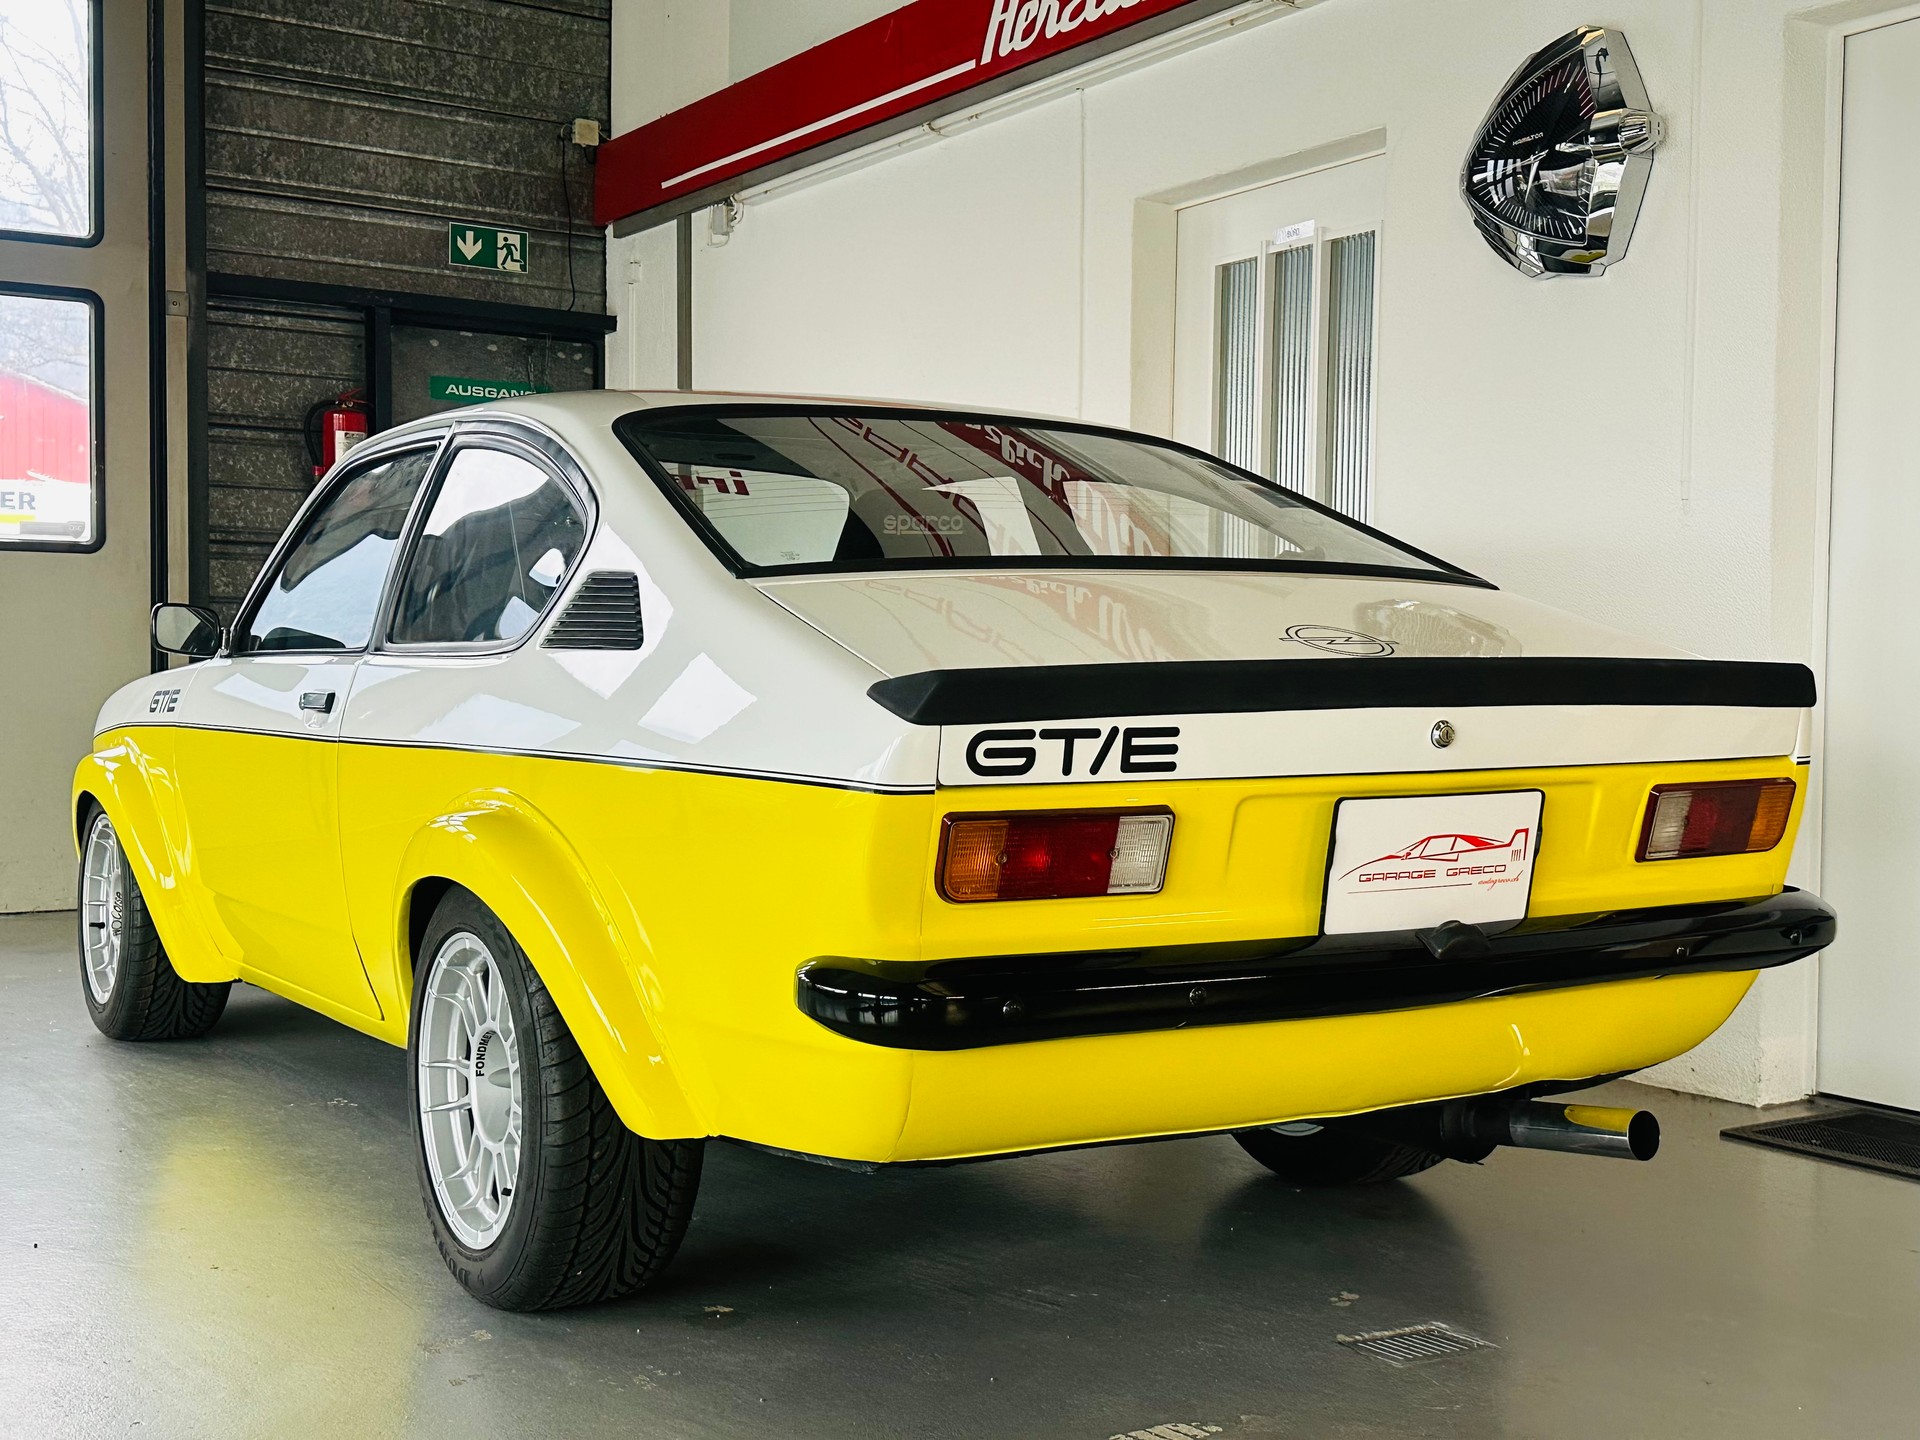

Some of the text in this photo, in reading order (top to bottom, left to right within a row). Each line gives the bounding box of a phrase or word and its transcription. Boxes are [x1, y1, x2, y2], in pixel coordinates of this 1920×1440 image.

[883, 514, 964, 536] sparco
[149, 689, 181, 713] GT/E
[966, 726, 1180, 777] GT/E
[1358, 864, 1507, 883] GARAGE GRECO
